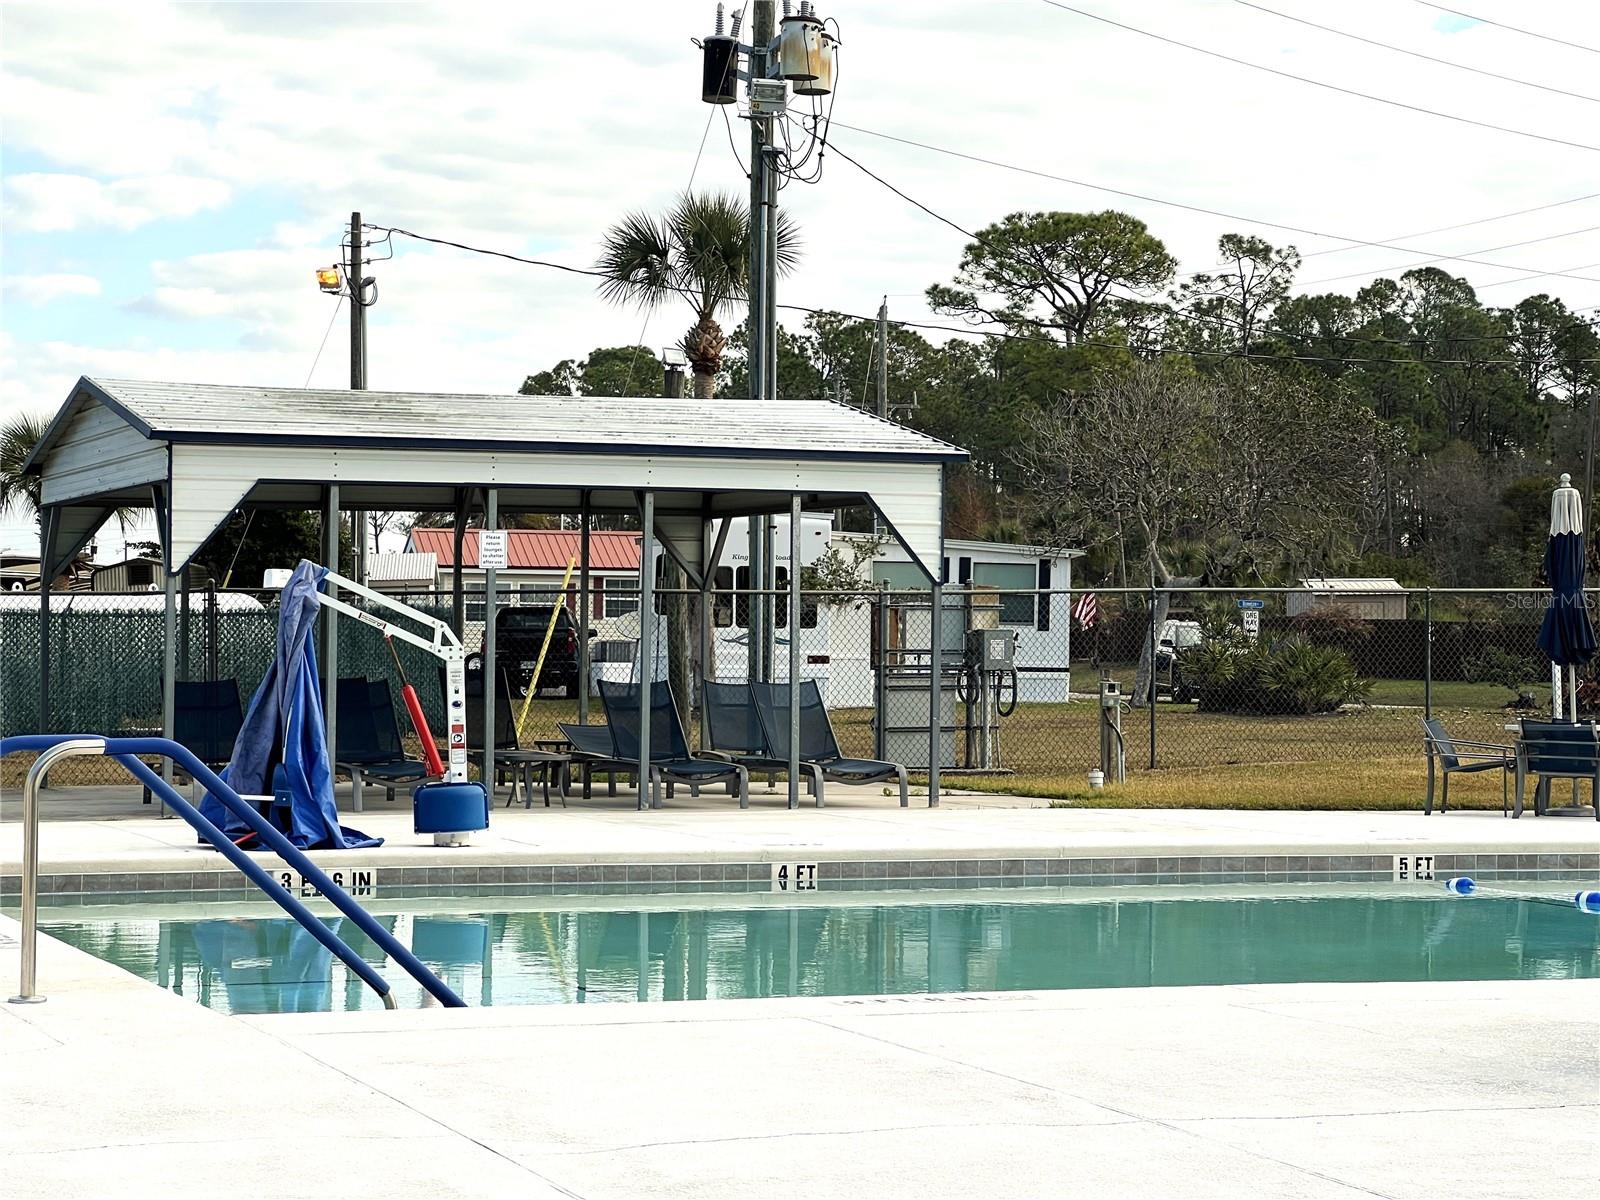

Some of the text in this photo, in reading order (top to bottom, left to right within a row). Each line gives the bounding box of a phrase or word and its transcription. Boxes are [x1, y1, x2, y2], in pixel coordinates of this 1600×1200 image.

[1399, 856, 1433, 871] 5 FT
[281, 872, 292, 889] 3
[352, 871, 371, 887] IN
[778, 864, 816, 880] 4 FT
